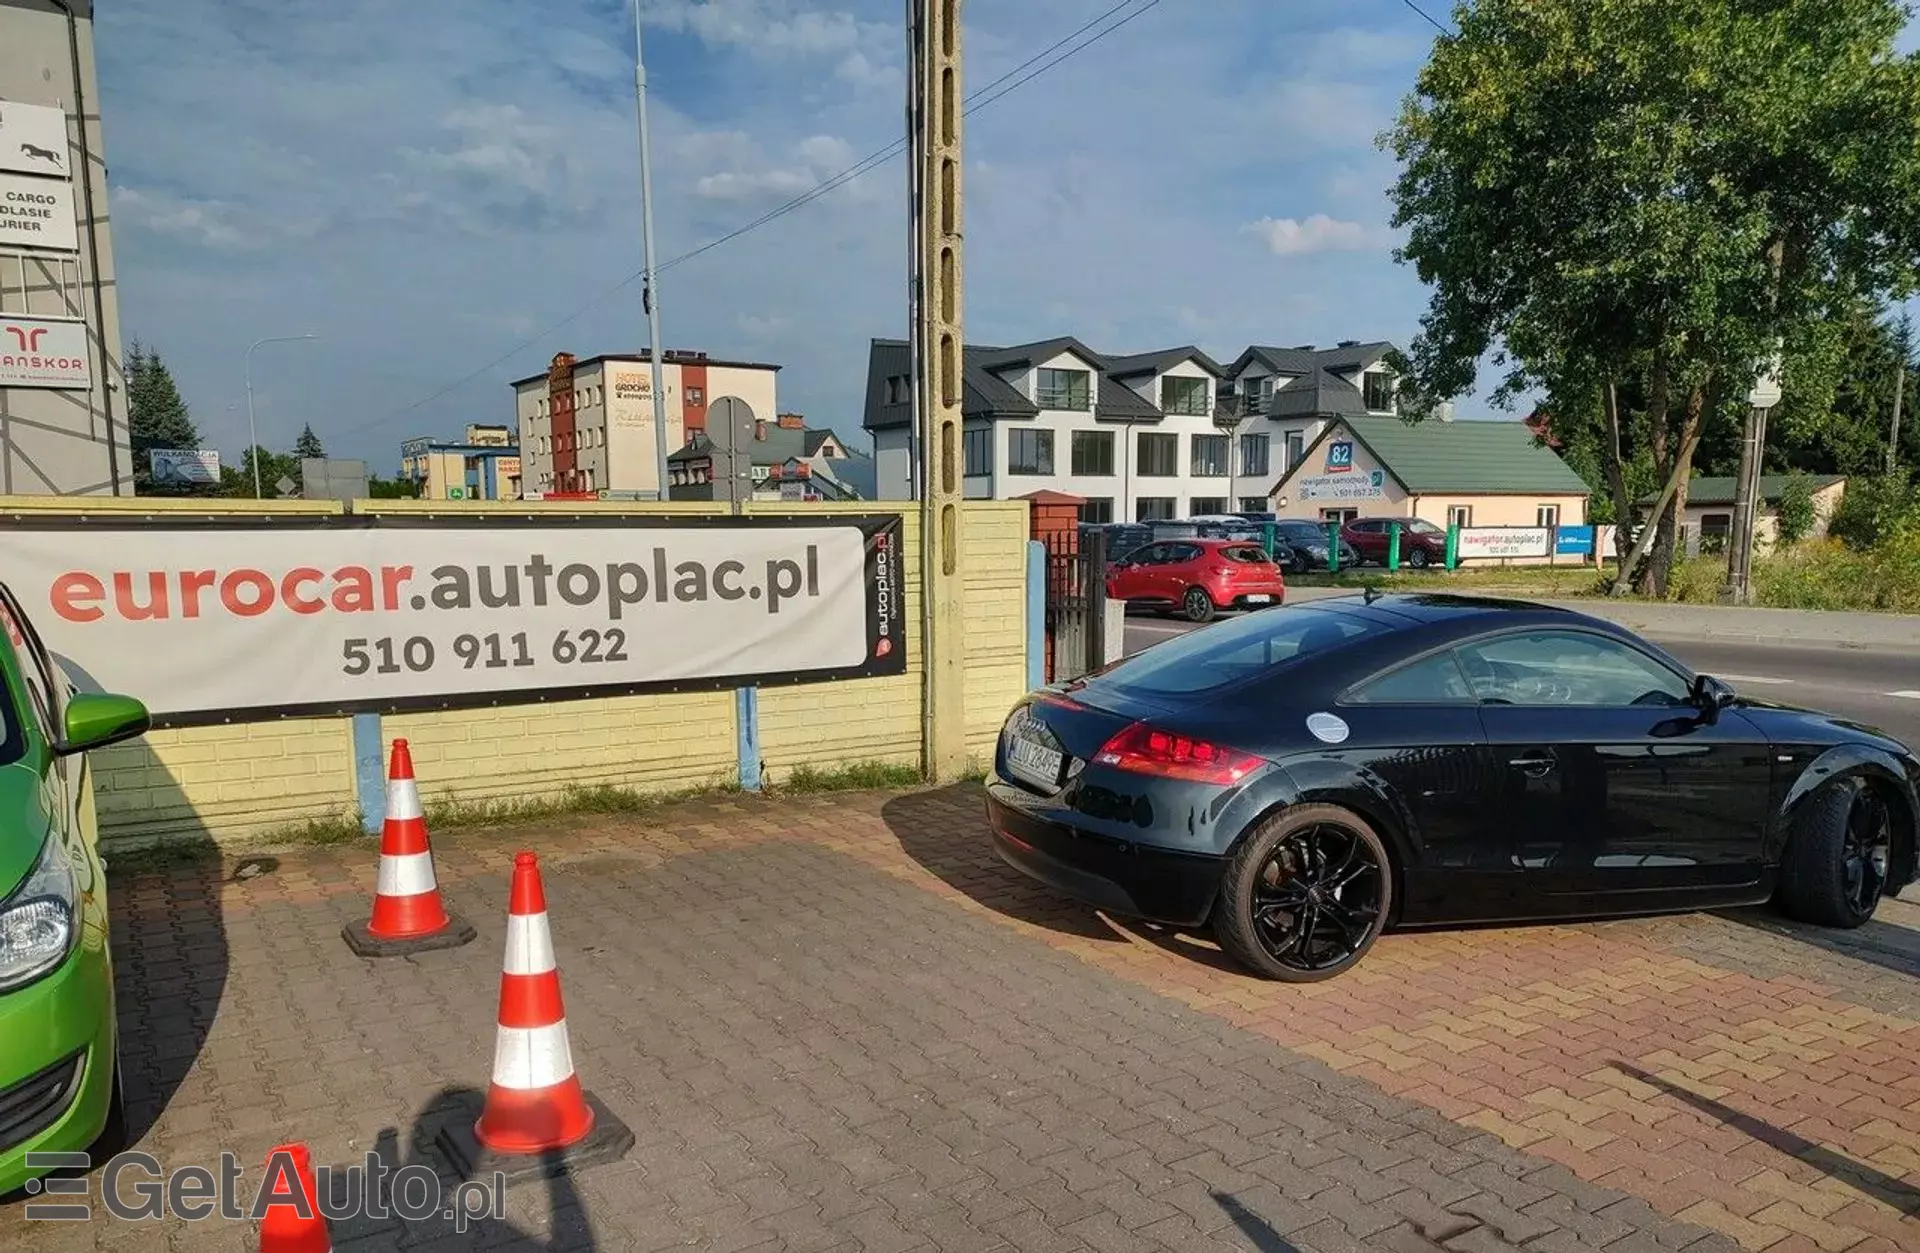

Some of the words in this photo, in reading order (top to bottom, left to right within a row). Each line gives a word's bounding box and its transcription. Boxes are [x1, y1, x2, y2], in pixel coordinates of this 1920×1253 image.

[6, 192, 56, 205] CARGO
[1332, 445, 1349, 463] 82
[50, 545, 820, 624] eurocar.autoplac.pl
[874, 532, 890, 636] autoplac.pl
[342, 636, 435, 676] 510
[453, 632, 535, 669] 911
[552, 628, 628, 664] 622
